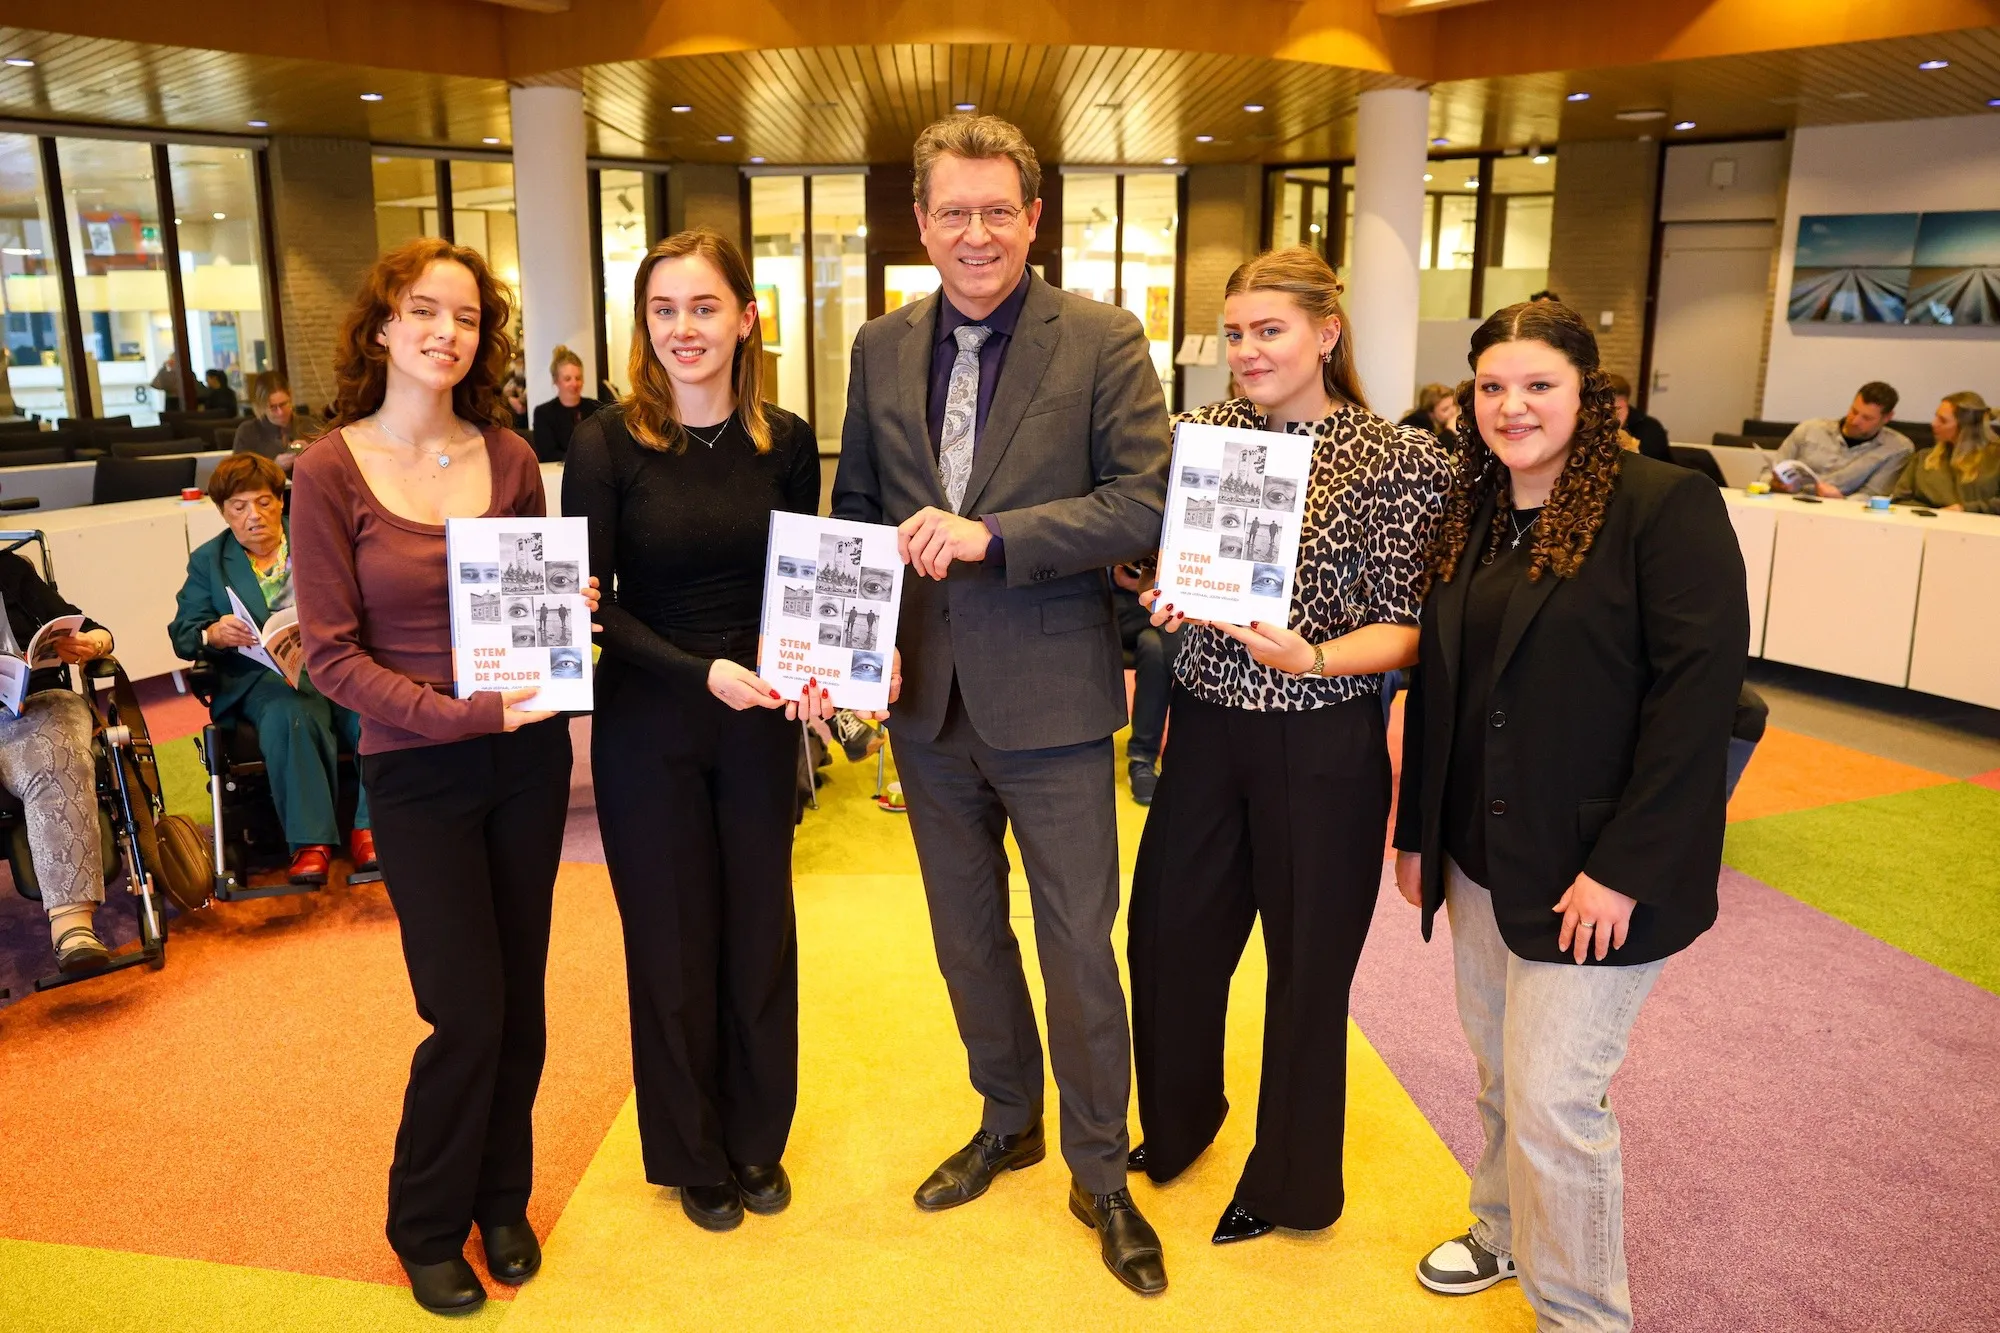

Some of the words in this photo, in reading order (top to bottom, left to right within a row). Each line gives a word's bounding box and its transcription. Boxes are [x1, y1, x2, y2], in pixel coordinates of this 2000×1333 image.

[135, 385, 147, 404] 8
[1180, 552, 1211, 564] STEM
[1179, 564, 1204, 576] VAN
[1176, 576, 1191, 587] DE
[1195, 578, 1241, 593] POLDER
[780, 638, 811, 650] STEM
[473, 648, 506, 657] STEM
[779, 650, 804, 661] VAN
[474, 660, 500, 669] VAN
[778, 661, 793, 671] DE
[796, 664, 841, 678] POLDER
[475, 672, 490, 681] DE
[494, 671, 540, 681] POLDER
